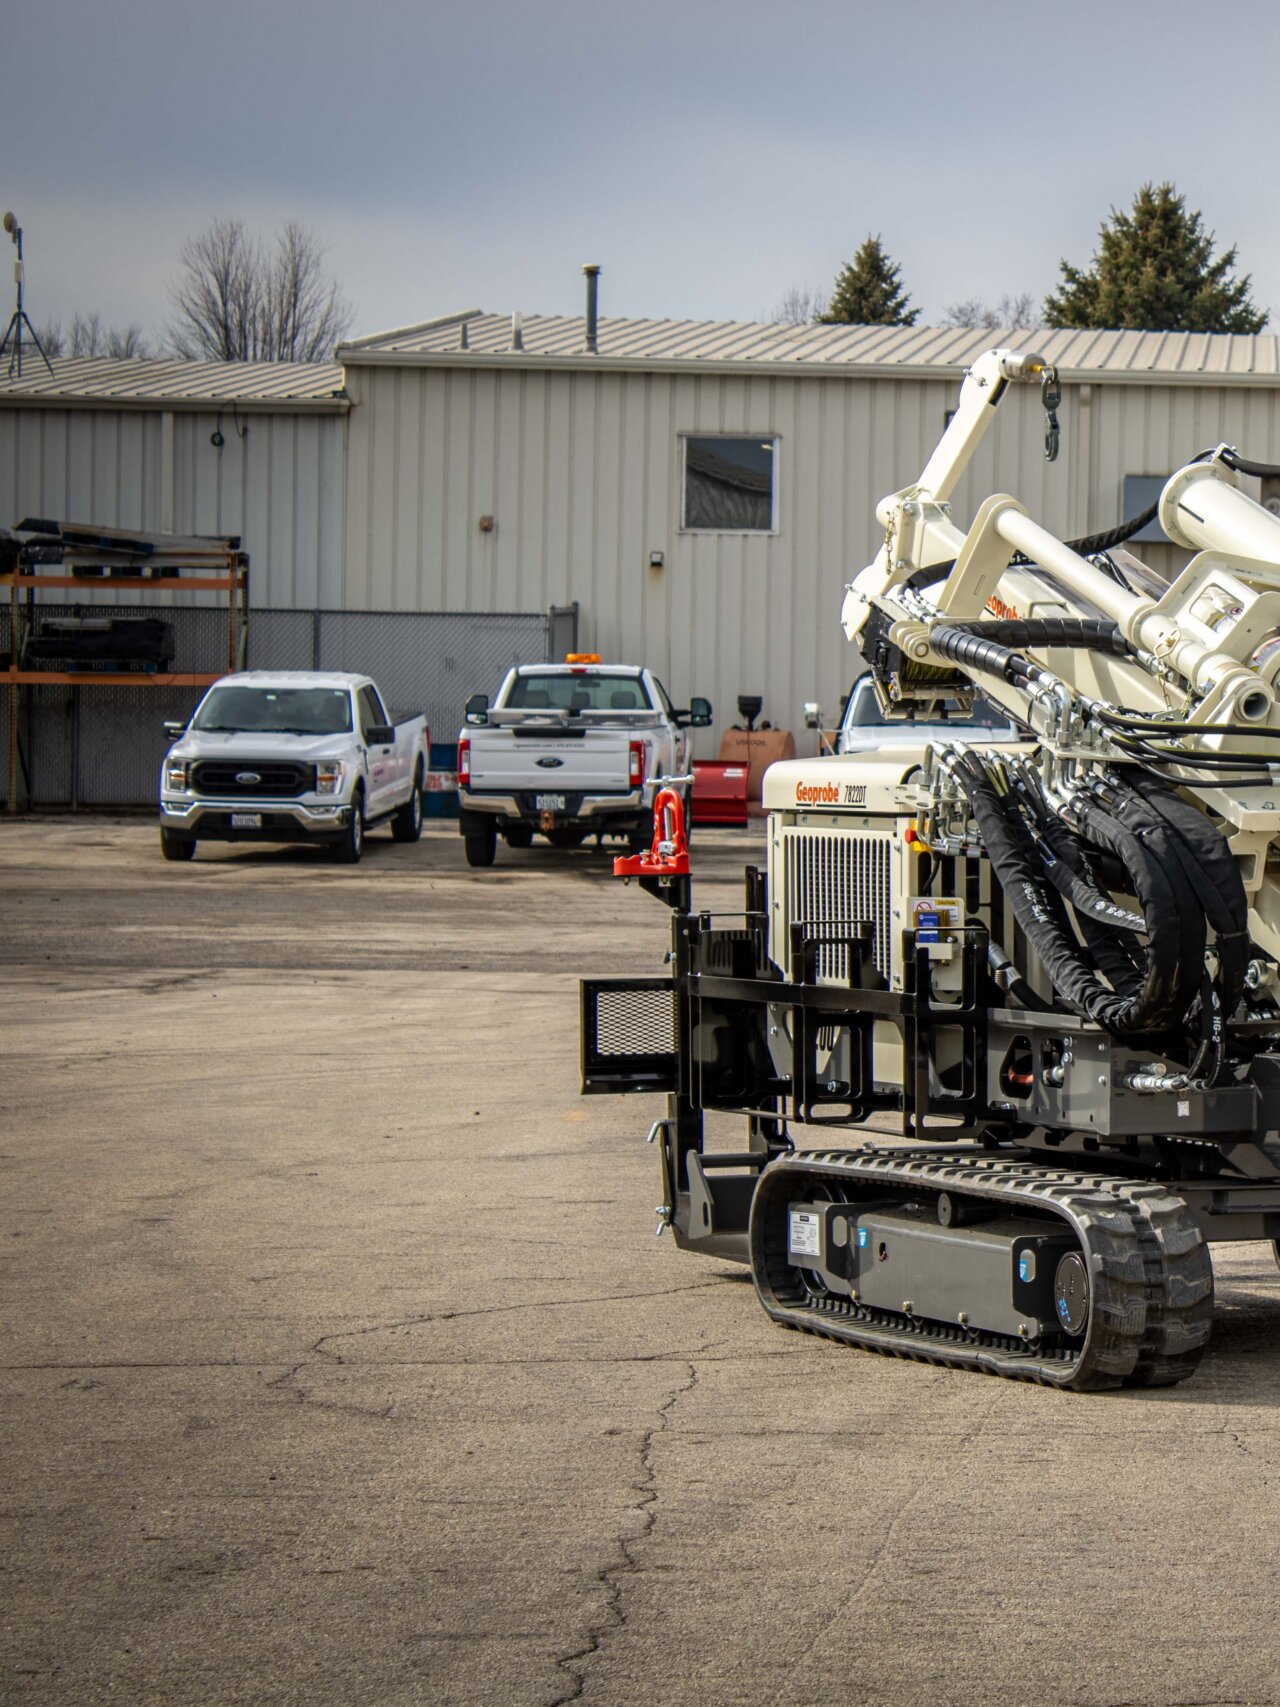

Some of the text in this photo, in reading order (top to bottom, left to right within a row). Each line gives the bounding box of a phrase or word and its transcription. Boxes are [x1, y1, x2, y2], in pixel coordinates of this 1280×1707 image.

[987, 595, 1018, 620] eoprob
[796, 781, 867, 807] Geoprobe 7822DT
[1212, 1016, 1221, 1043] HG-2
